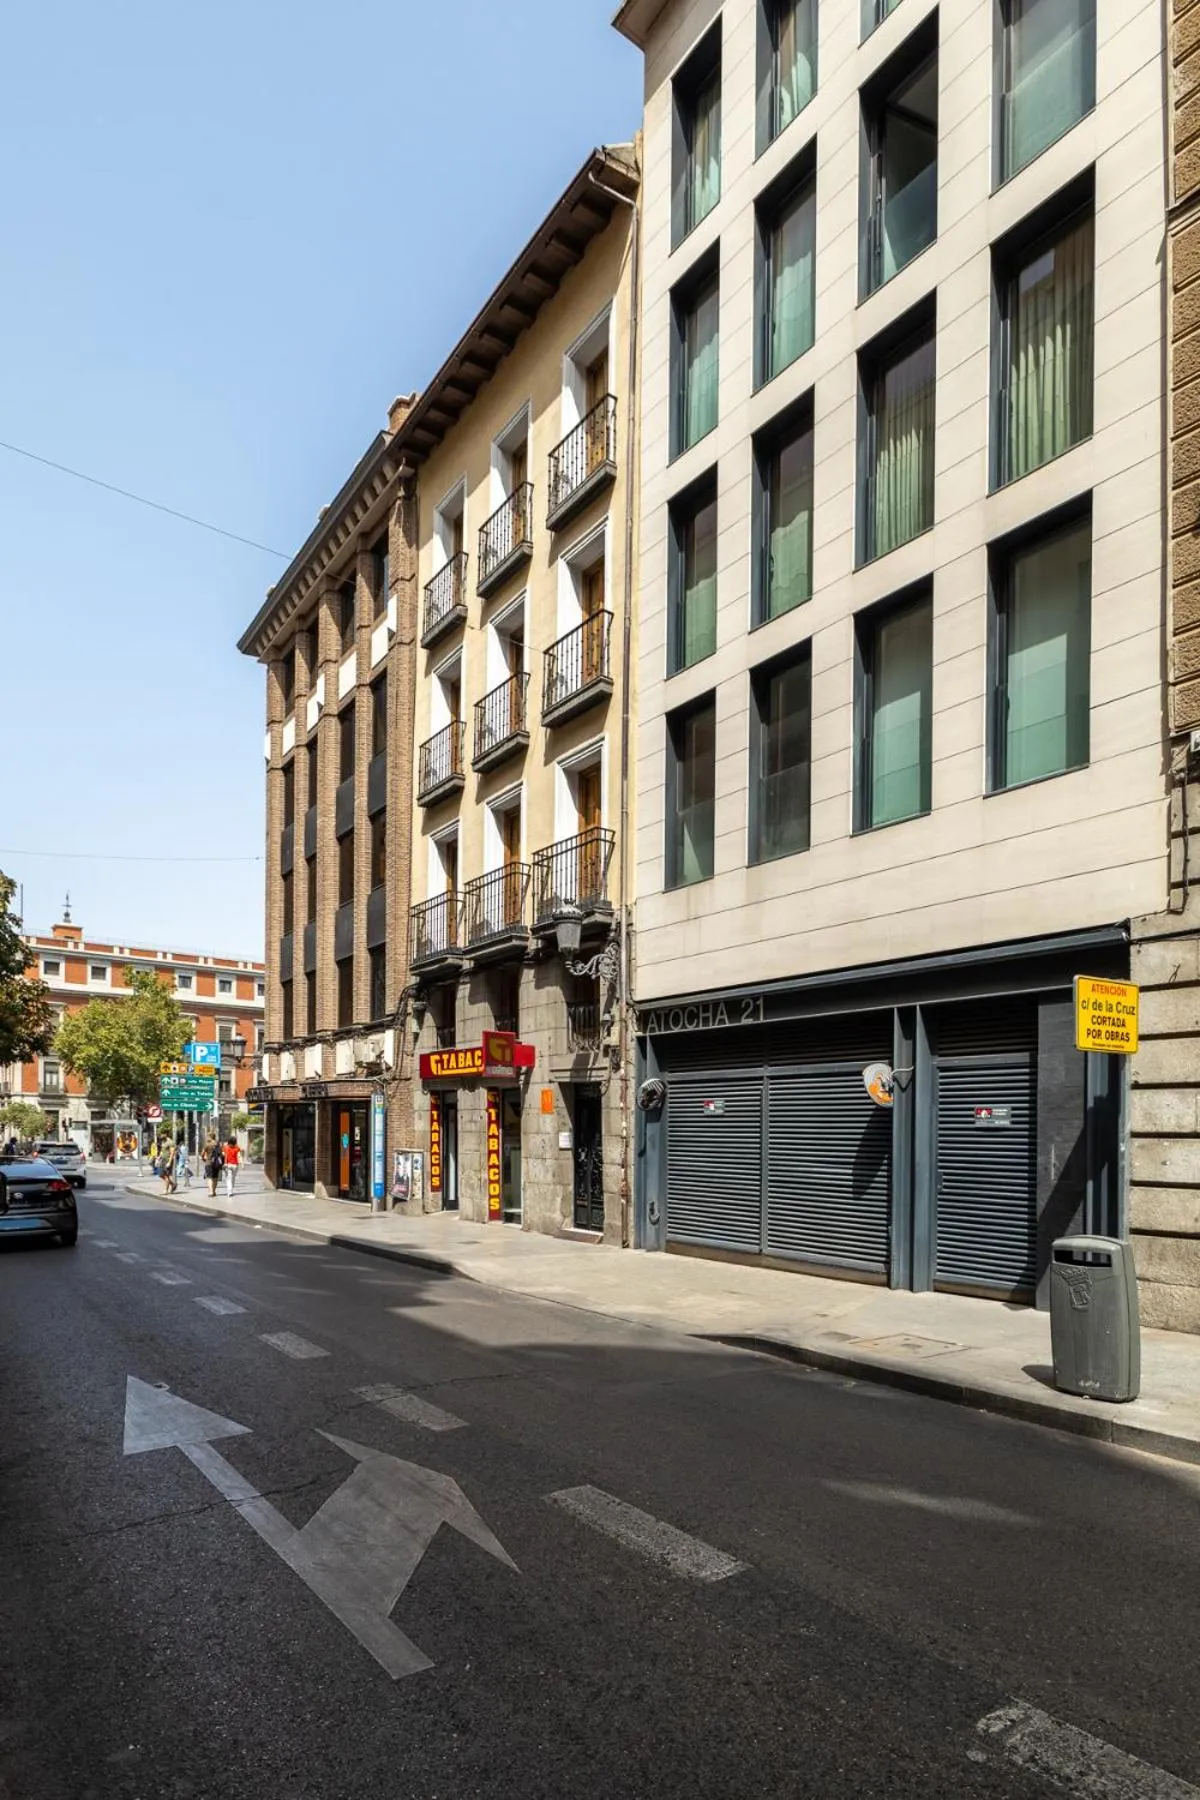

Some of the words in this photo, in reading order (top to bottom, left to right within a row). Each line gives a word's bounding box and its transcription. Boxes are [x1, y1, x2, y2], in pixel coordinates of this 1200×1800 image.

[647, 1000, 729, 1033] ATOCHA
[741, 996, 764, 1024] 21
[1081, 998, 1090, 1010] c/
[1092, 999, 1103, 1011] de
[1105, 1000, 1113, 1012] la
[1116, 1001, 1135, 1015] Cruz
[1091, 1015, 1126, 1028] CORTADA
[1087, 1028, 1102, 1040] POR
[1105, 1030, 1130, 1042] OBRAS
[196, 1046, 208, 1061] P
[431, 1110, 440, 1186] TABACOS
[489, 1108, 500, 1210] TABACOS
